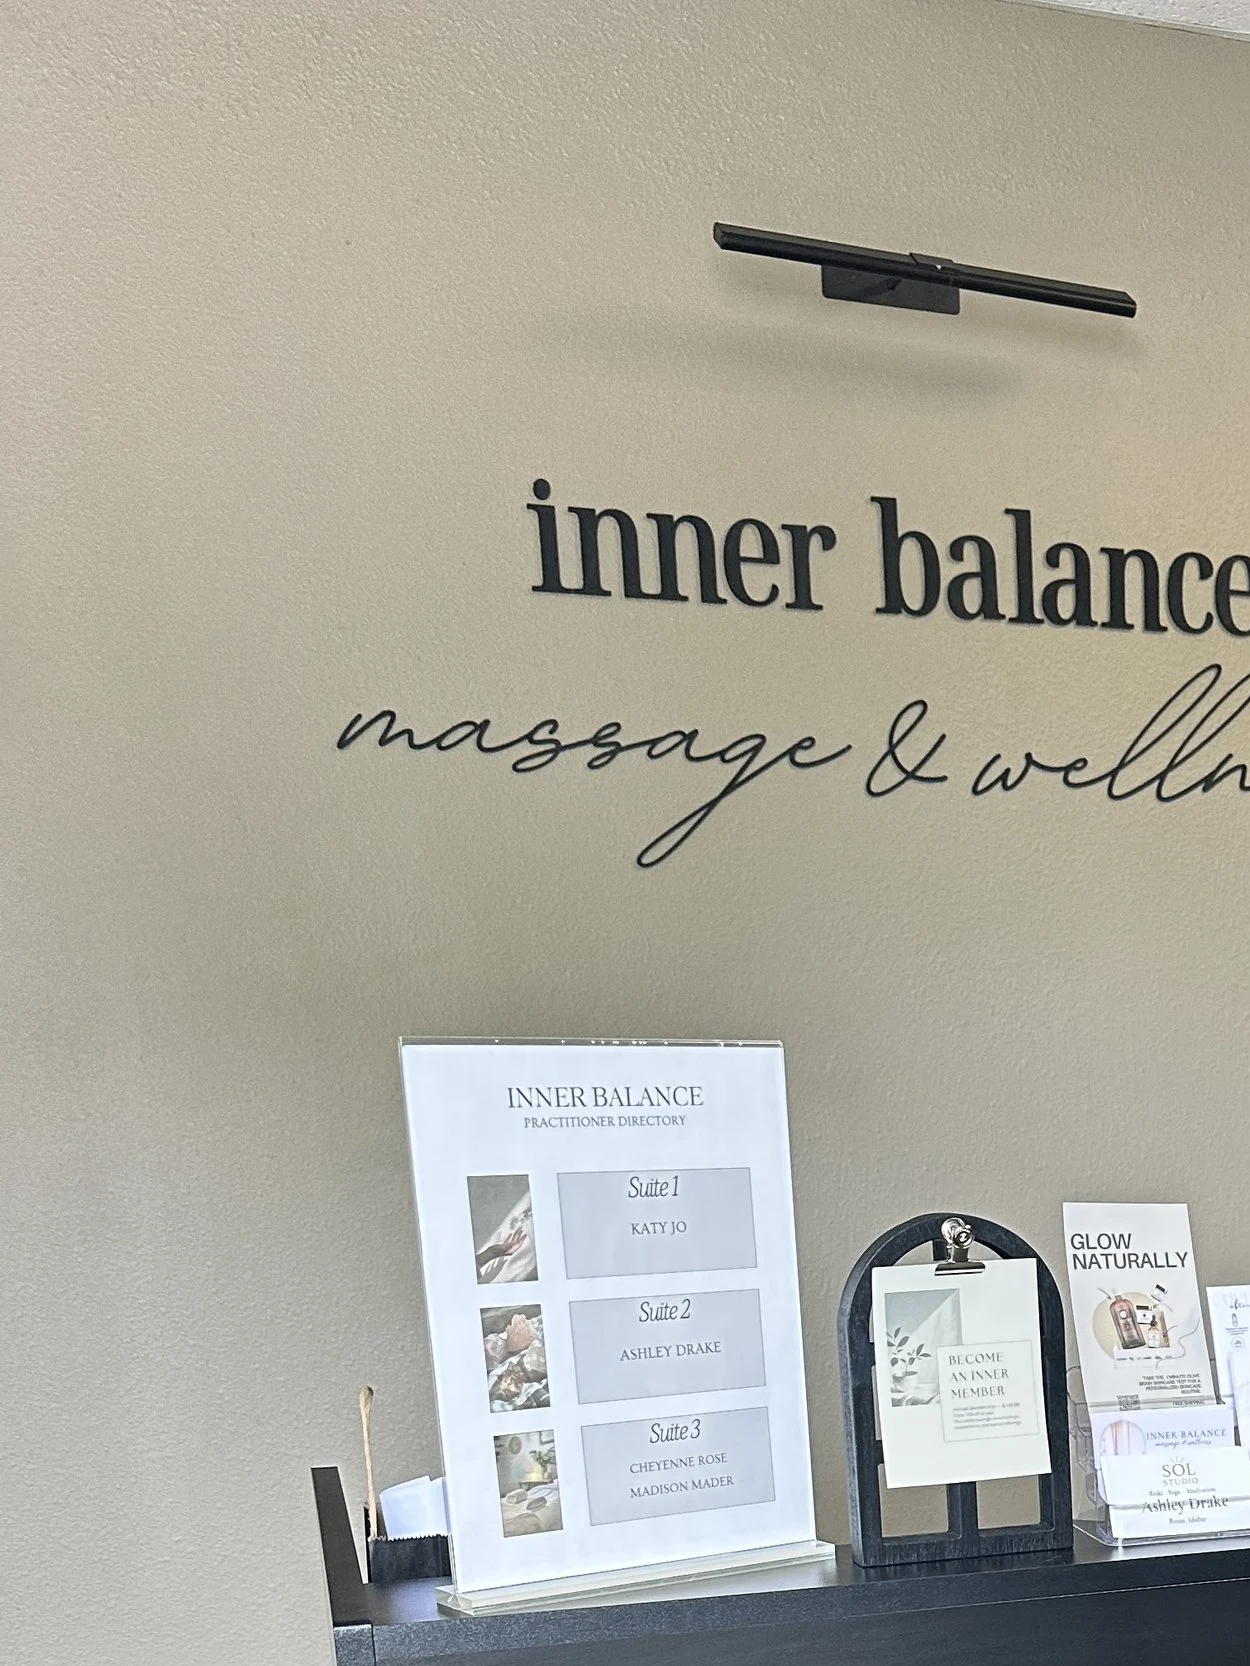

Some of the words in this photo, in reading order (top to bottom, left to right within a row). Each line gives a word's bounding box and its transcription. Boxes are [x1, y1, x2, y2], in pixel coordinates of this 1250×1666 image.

[527, 479, 837, 612] inner
[337, 708, 852, 868] massage
[863, 699, 950, 797] &
[508, 1086, 587, 1110] INNER
[592, 1085, 705, 1108] BALANCE
[524, 1115, 616, 1129] PRACTITIONER
[618, 1114, 686, 1127] DIRECTORY
[627, 1177, 669, 1200] Suite
[671, 1175, 680, 1198] 1
[630, 1220, 668, 1236] KATY
[670, 1220, 687, 1235] JO
[1070, 1233, 1132, 1251] GLOW
[1072, 1251, 1189, 1271] NATURALLY
[638, 1301, 678, 1324] Suite
[680, 1299, 691, 1321] 2
[620, 1344, 673, 1362] ASHLEY
[676, 1341, 722, 1357] DRAKE
[948, 1352, 1004, 1366] BECOME
[950, 1371, 967, 1382] AN
[971, 1368, 1009, 1381] INNER
[951, 1385, 1005, 1399] MEMBER
[649, 1422, 689, 1445] Suite
[690, 1419, 702, 1441] 3
[1146, 1430, 1178, 1440] INNER
[1181, 1428, 1228, 1439] BALANCE
[629, 1456, 695, 1475] CHEYENNE
[697, 1452, 728, 1467] ROSE
[1162, 1463, 1196, 1477] SOL
[629, 1479, 689, 1499] MADISON
[691, 1476, 735, 1492] MADER
[1162, 1477, 1199, 1486] STUDIO
[1142, 1498, 1184, 1515] Ashley
[1188, 1495, 1229, 1510] Drake
